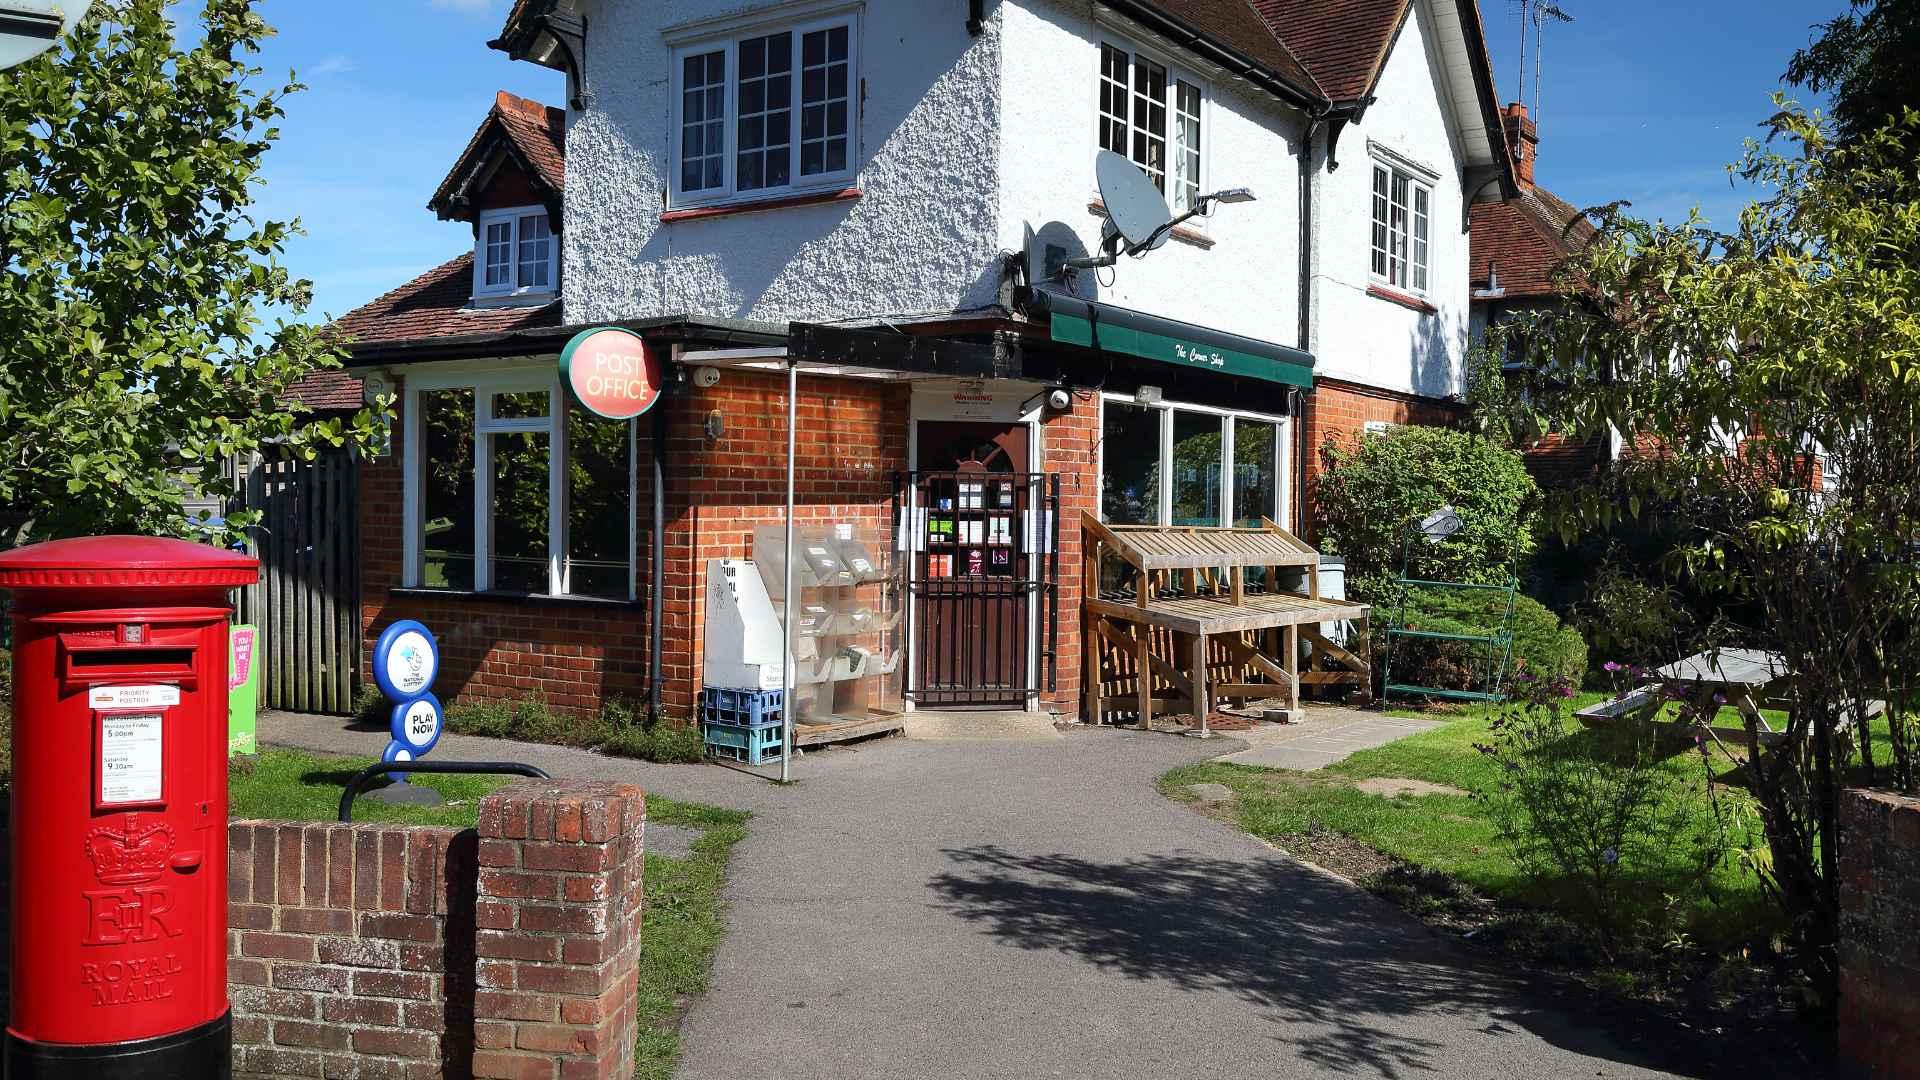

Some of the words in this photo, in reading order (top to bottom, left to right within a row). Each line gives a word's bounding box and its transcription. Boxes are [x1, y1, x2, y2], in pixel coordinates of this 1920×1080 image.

[595, 351, 643, 377] POST
[1175, 344, 1186, 359] The
[1210, 353, 1225, 368] Shop
[586, 375, 649, 401] OFFICE
[119, 689, 150, 697] PRIORITY
[412, 713, 434, 725] PLAY
[412, 724, 434, 735] NOW
[81, 954, 182, 985] ROYAL
[91, 979, 173, 1008] MAIL
